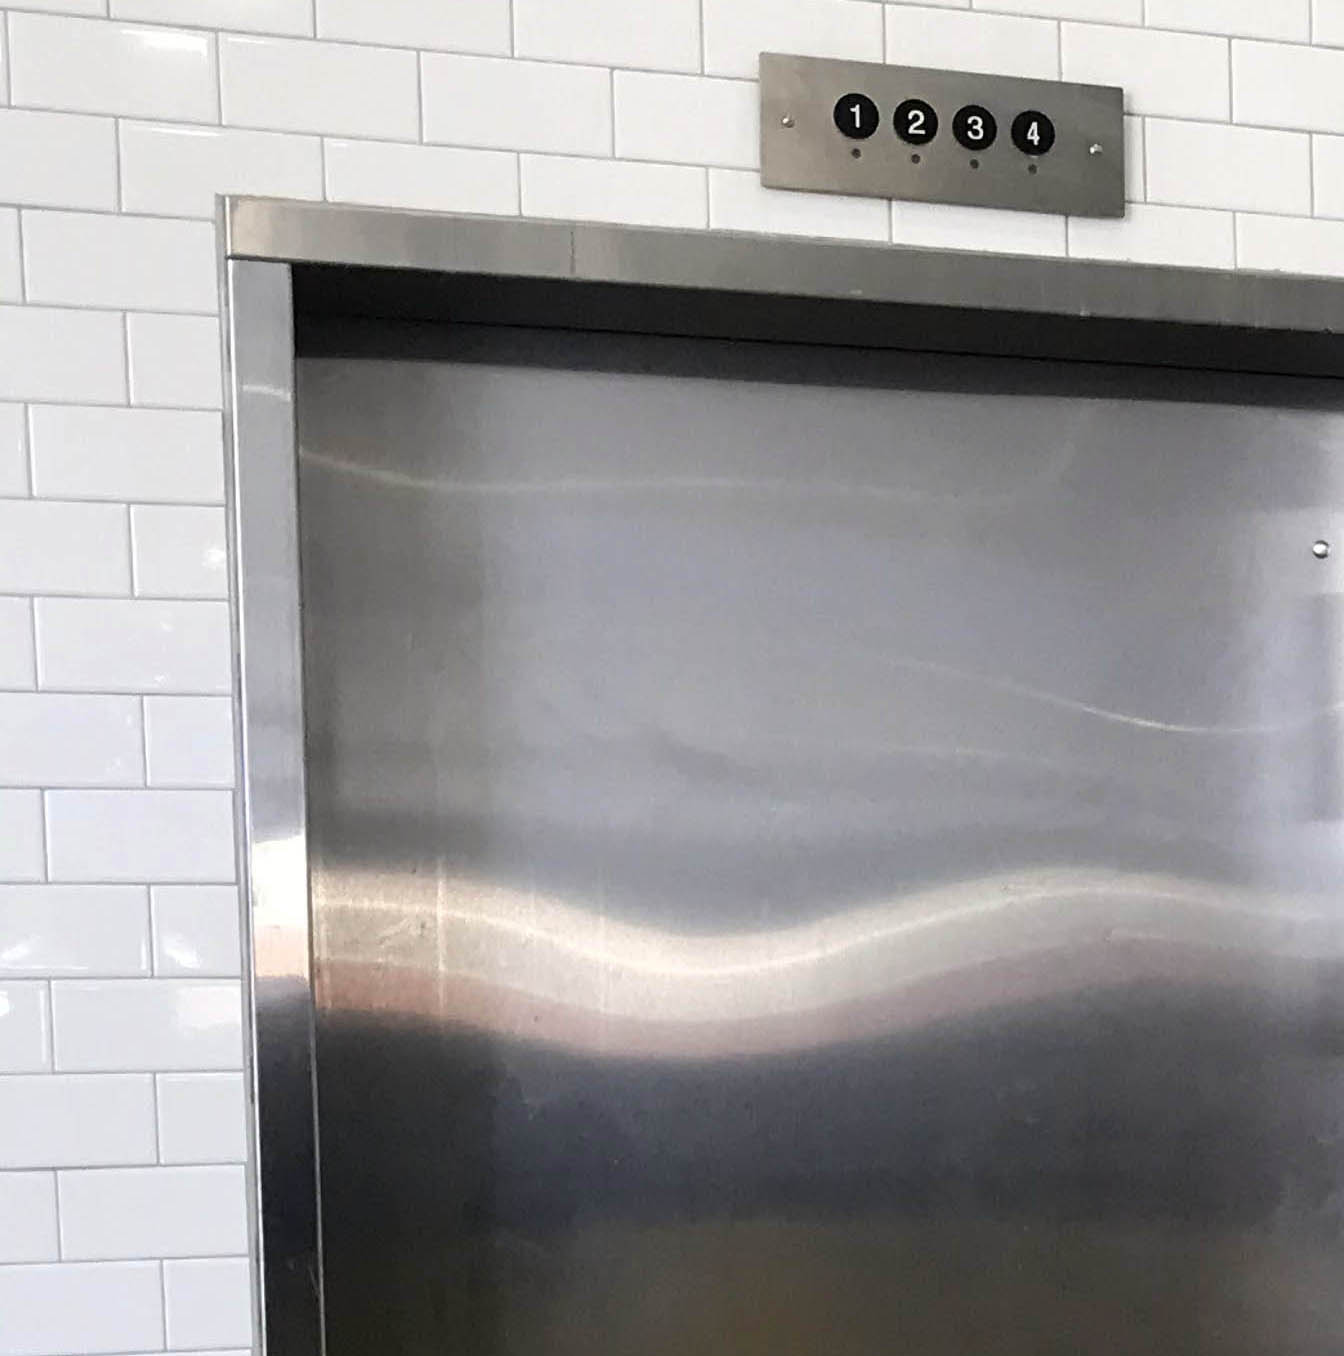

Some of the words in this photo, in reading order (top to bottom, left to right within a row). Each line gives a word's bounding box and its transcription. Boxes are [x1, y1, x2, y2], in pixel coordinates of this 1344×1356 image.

[849, 104, 861, 128] 1
[908, 110, 926, 135] 2
[967, 116, 984, 140] 3
[1026, 121, 1041, 145] 4
